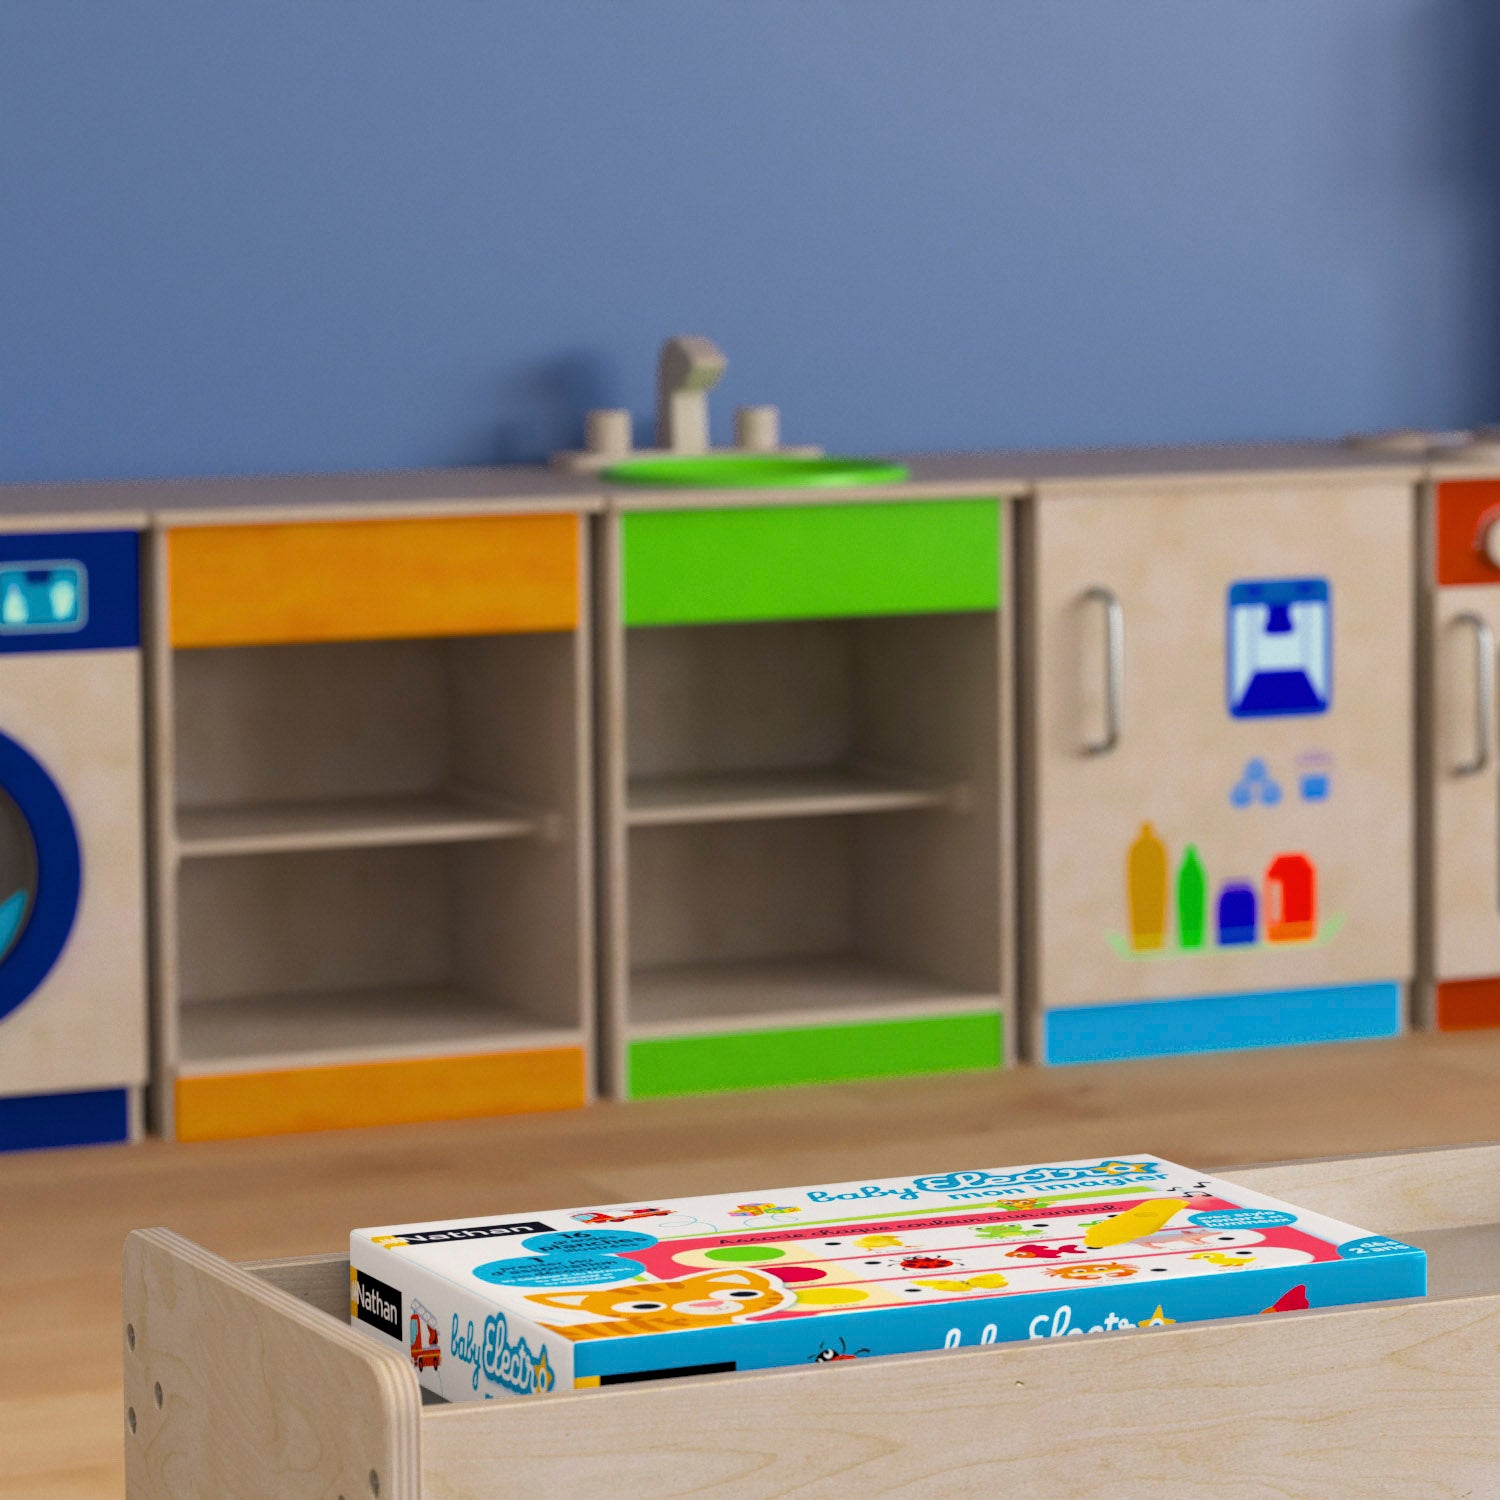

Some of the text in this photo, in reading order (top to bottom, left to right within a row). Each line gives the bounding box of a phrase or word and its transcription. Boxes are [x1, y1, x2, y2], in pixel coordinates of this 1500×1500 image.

[807, 1162, 1144, 1203] baby Electro
[949, 1172, 1169, 1200] mon imagier
[402, 1222, 535, 1245] Nathan
[896, 1218, 986, 1229] couleur
[538, 1236, 649, 1253] planches
[557, 1231, 592, 1240] 16
[1348, 1244, 1411, 1255] 2 ans
[356, 1280, 399, 1326] Nathan
[450, 1313, 552, 1393] baby Electro
